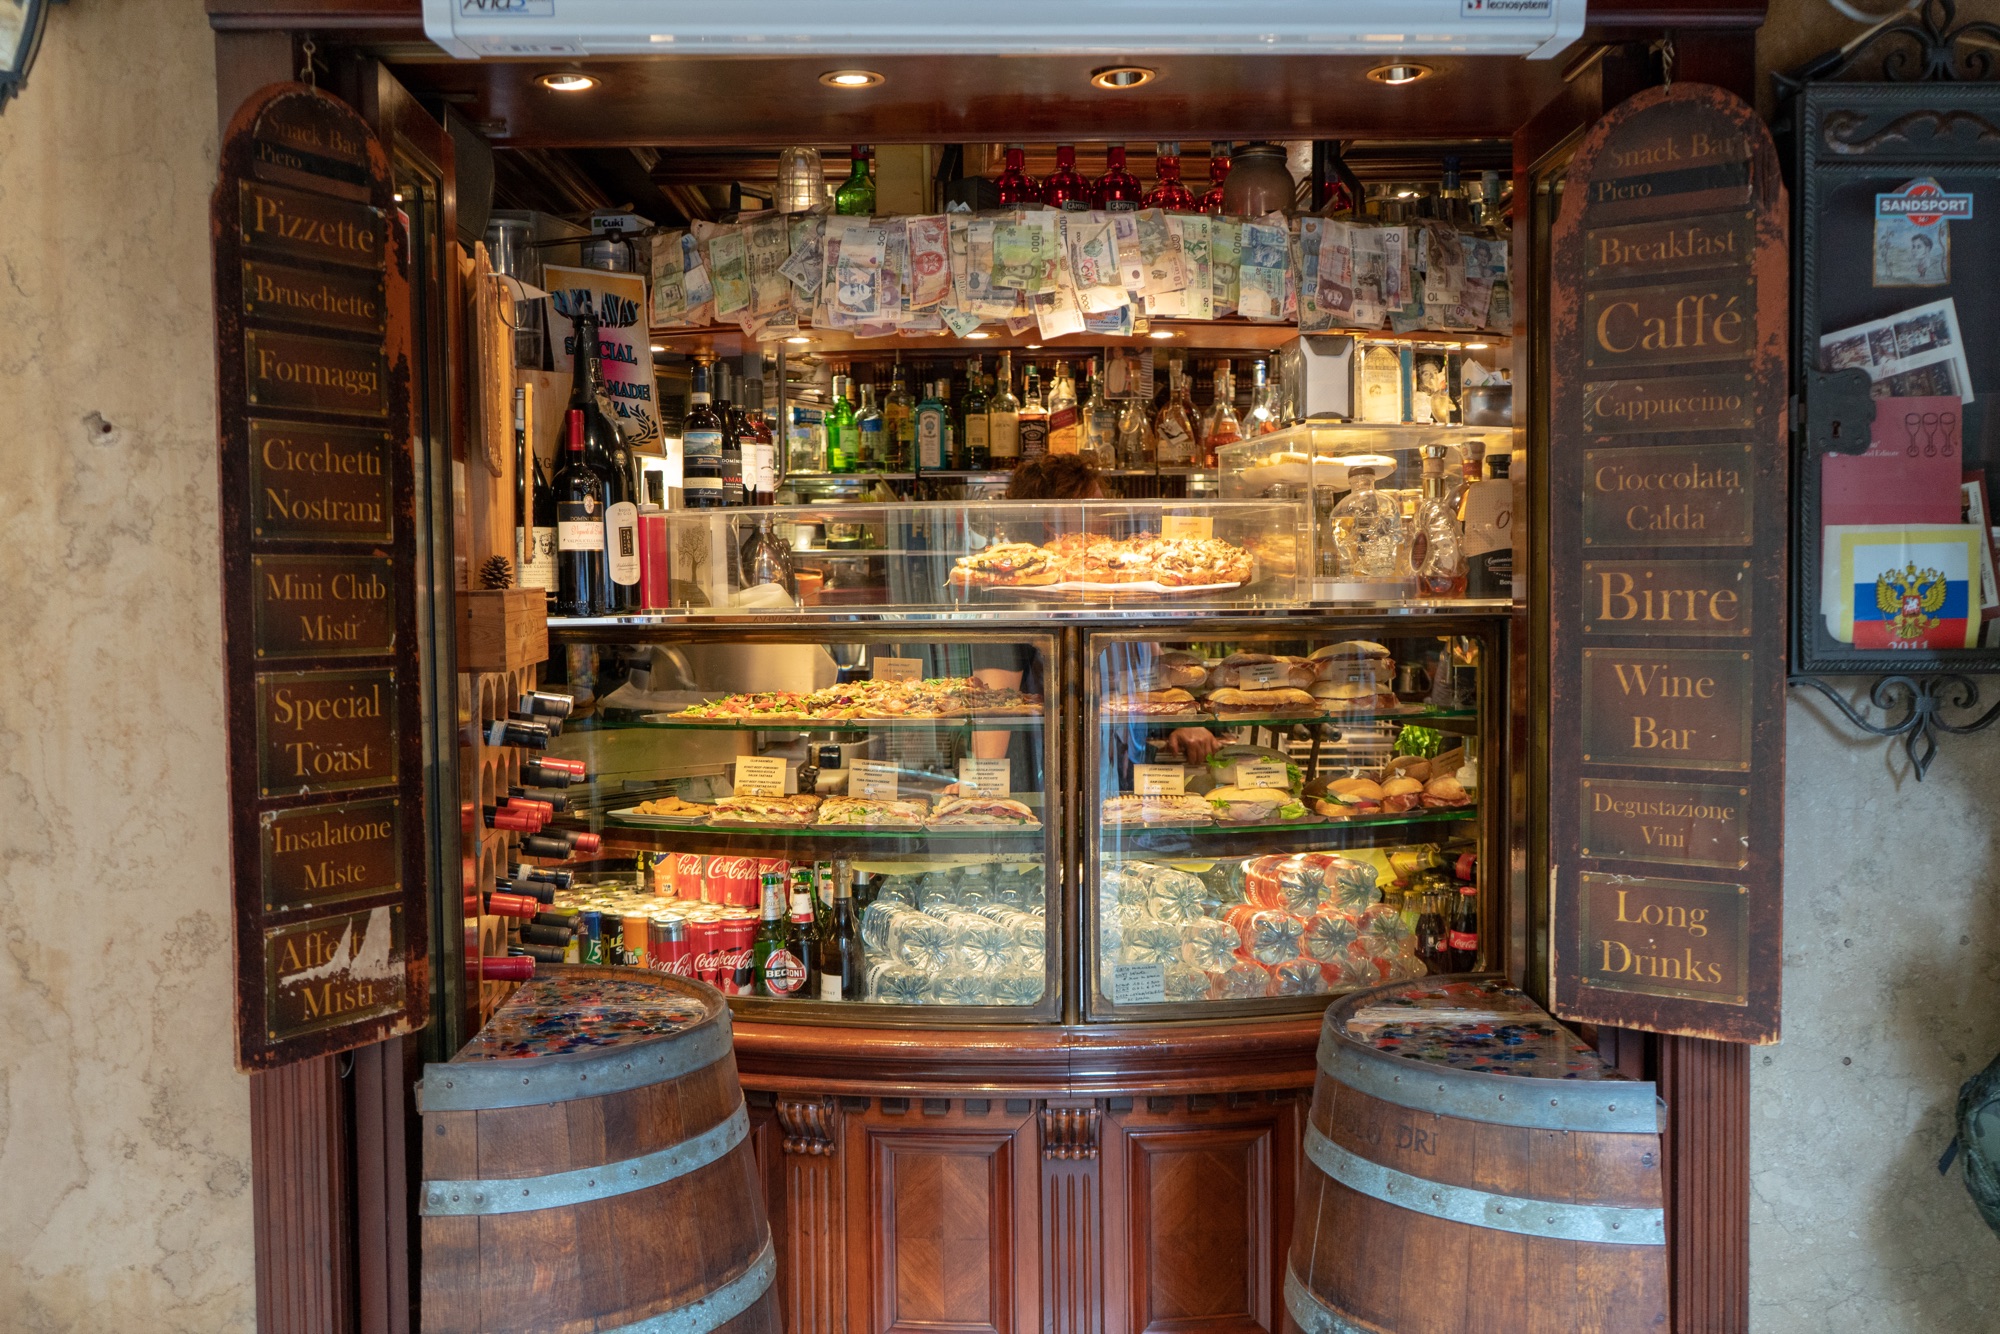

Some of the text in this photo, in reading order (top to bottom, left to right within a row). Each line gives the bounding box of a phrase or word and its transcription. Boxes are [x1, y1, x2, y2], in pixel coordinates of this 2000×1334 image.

[259, 141, 303, 169] Piero
[1598, 181, 1653, 202] Piero
[1881, 199, 1968, 212] SANDSPORT
[255, 195, 375, 253] Pizzette
[602, 217, 625, 228] Cuki
[1385, 232, 1400, 243] 20
[1031, 231, 1041, 253] 1000
[1600, 227, 1738, 267] Breakfast
[256, 274, 377, 319] Bruschette
[1596, 292, 1743, 355] Caffé
[564, 335, 638, 366] SCIAL
[258, 349, 378, 396] Formaggi
[1594, 392, 1743, 422] Cappuccino
[262, 437, 382, 477] Cicchetti
[1594, 462, 1741, 492] Cioccolata
[265, 486, 383, 523] Nostrani
[1626, 503, 1707, 532] Calda
[267, 572, 387, 601] Mini Club
[1596, 571, 1739, 622] Birre
[300, 614, 359, 642] Misti
[1613, 663, 1716, 699] Wine
[274, 683, 382, 731] Special
[1631, 715, 1697, 751] Bar
[285, 741, 373, 778] Toast
[1592, 792, 1736, 821] Degustazione
[273, 819, 393, 854] Insalatone
[1640, 824, 1685, 849] Vini
[303, 860, 367, 891] Miste
[1614, 889, 1710, 938] Long
[1599, 939, 1723, 985] Drinks
[302, 979, 374, 1021] Misti
